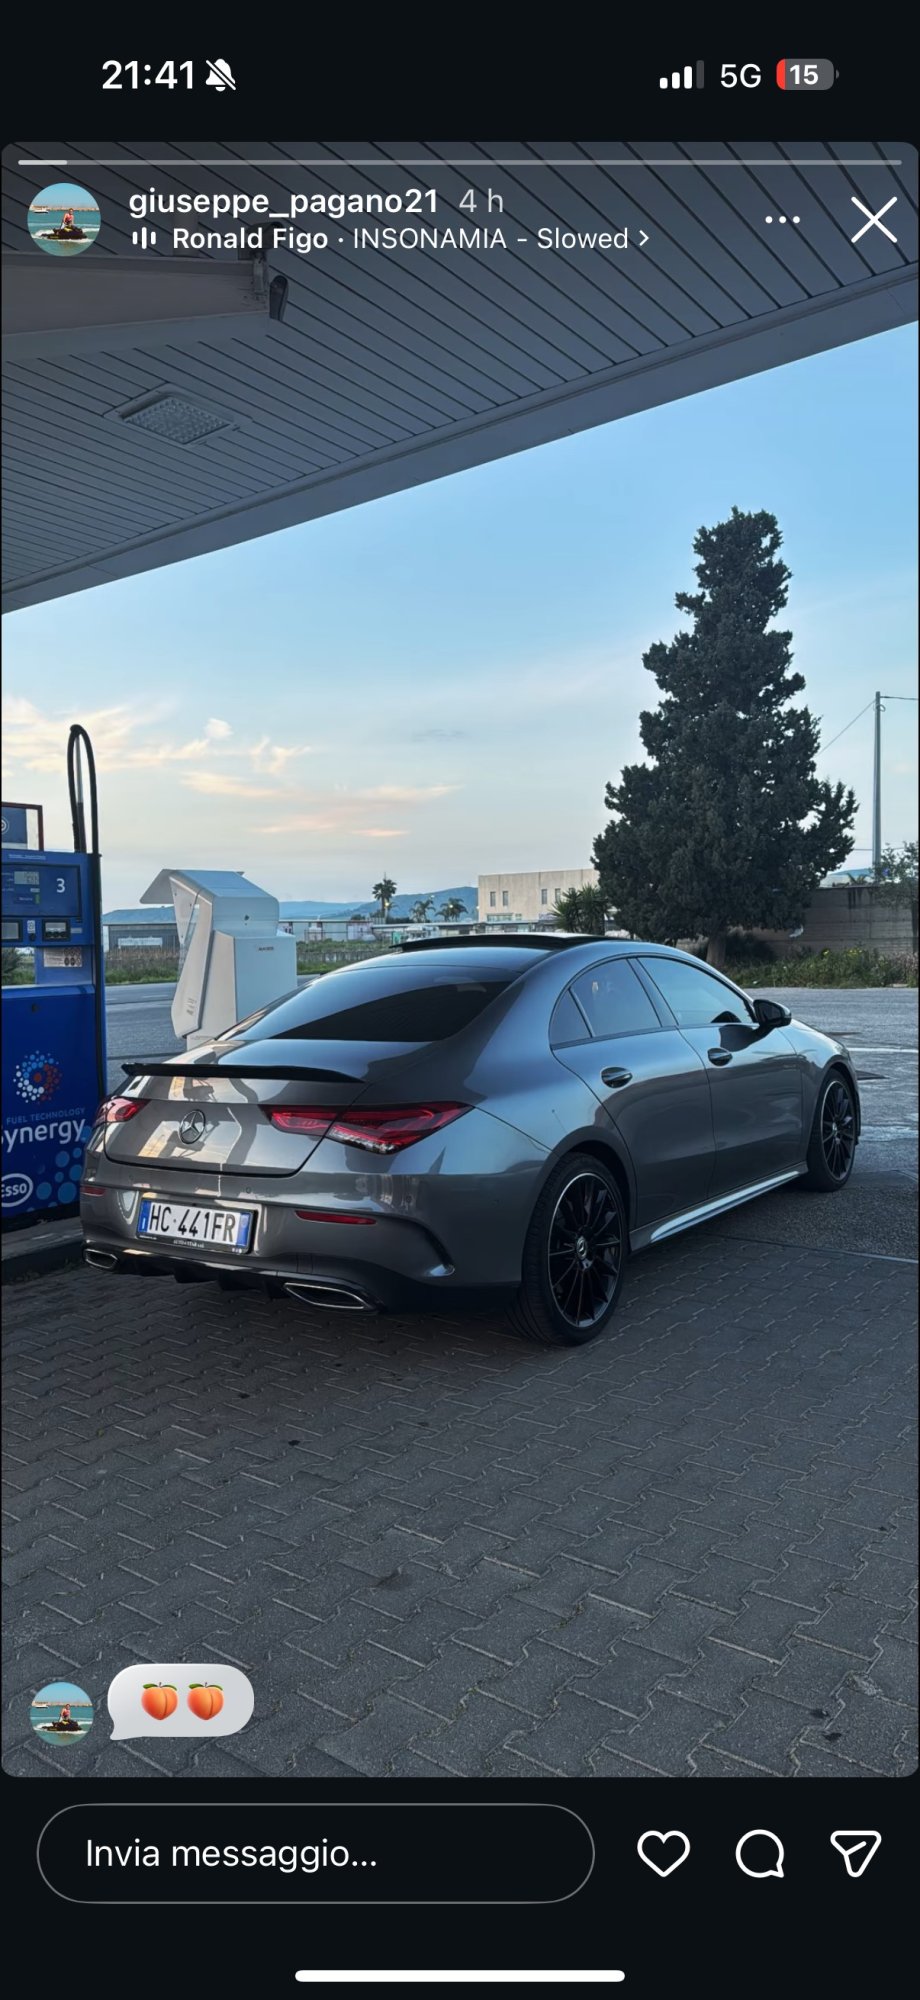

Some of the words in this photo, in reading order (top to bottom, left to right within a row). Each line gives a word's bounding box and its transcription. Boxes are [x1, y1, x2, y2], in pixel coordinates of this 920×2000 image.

[56, 878, 66, 893] 3
[6, 1116, 28, 1125] FUEL
[30, 1107, 86, 1120] TECHNOLOGY
[1, 1118, 86, 1153] ynergy
